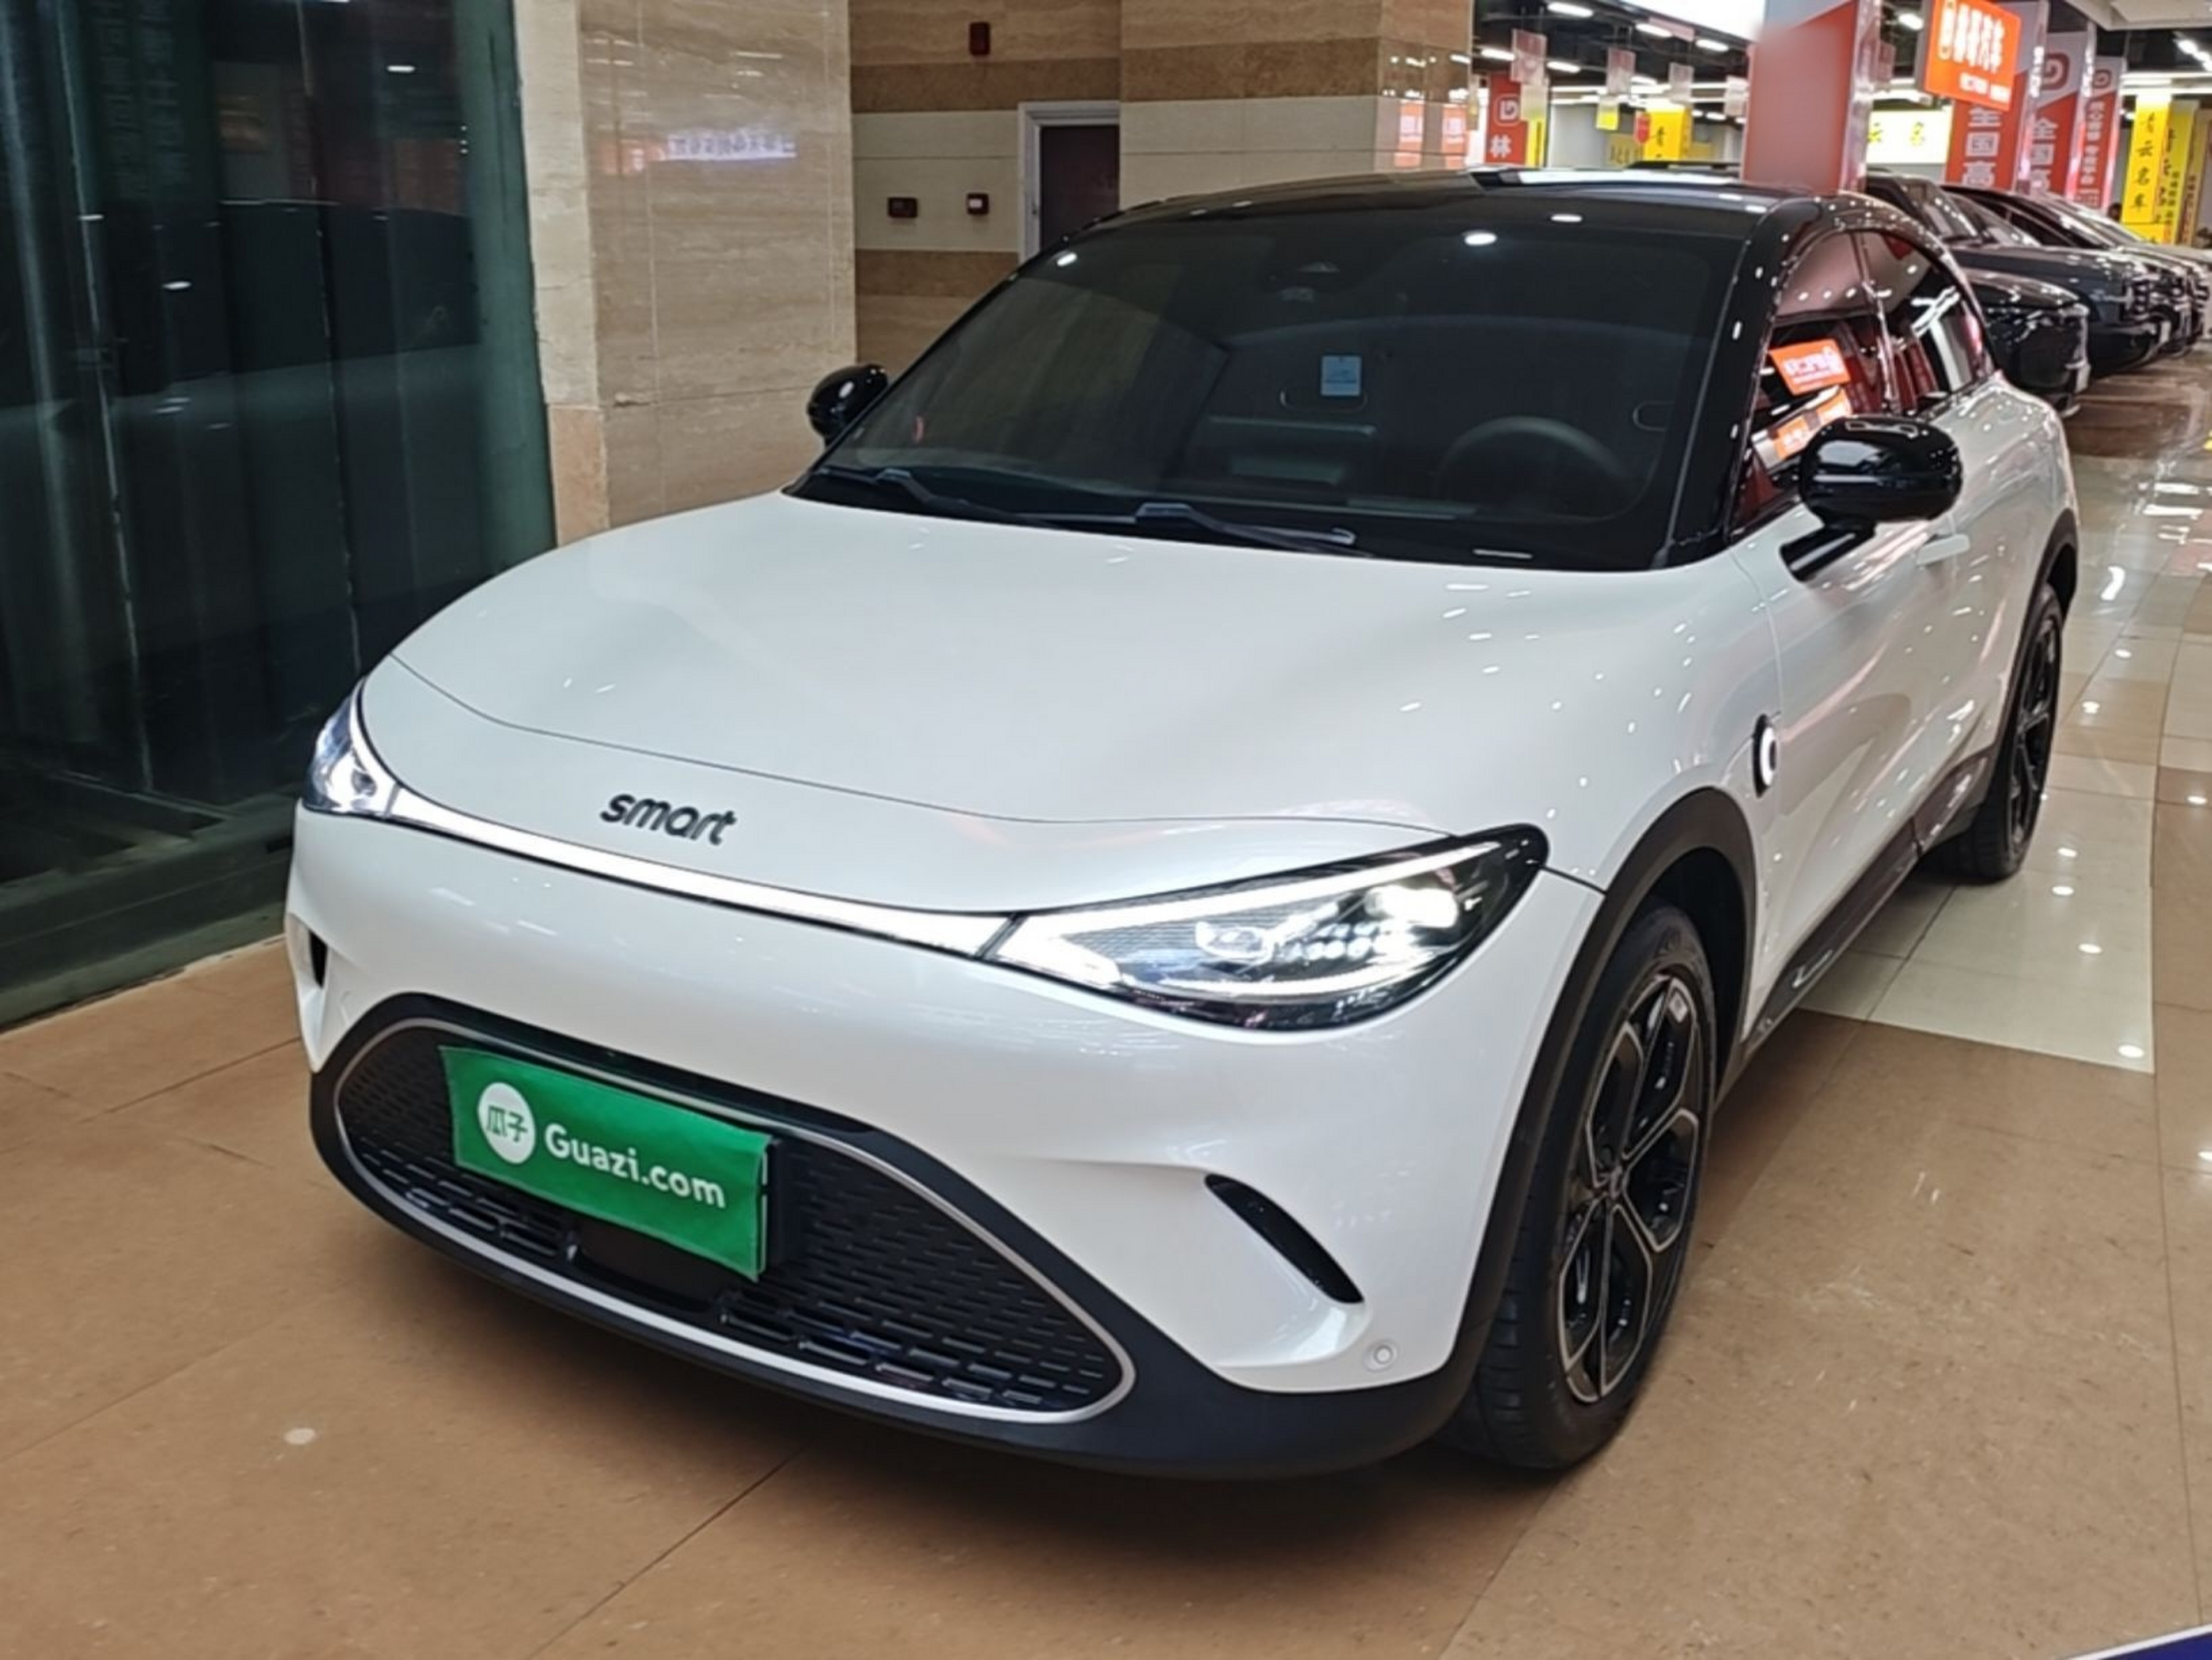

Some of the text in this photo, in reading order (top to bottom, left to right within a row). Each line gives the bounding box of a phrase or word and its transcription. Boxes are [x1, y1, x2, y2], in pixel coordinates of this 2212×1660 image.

[600, 793, 737, 845] smart
[486, 1105, 528, 1143] 瓜子
[544, 1122, 726, 1209] Guazi.com
